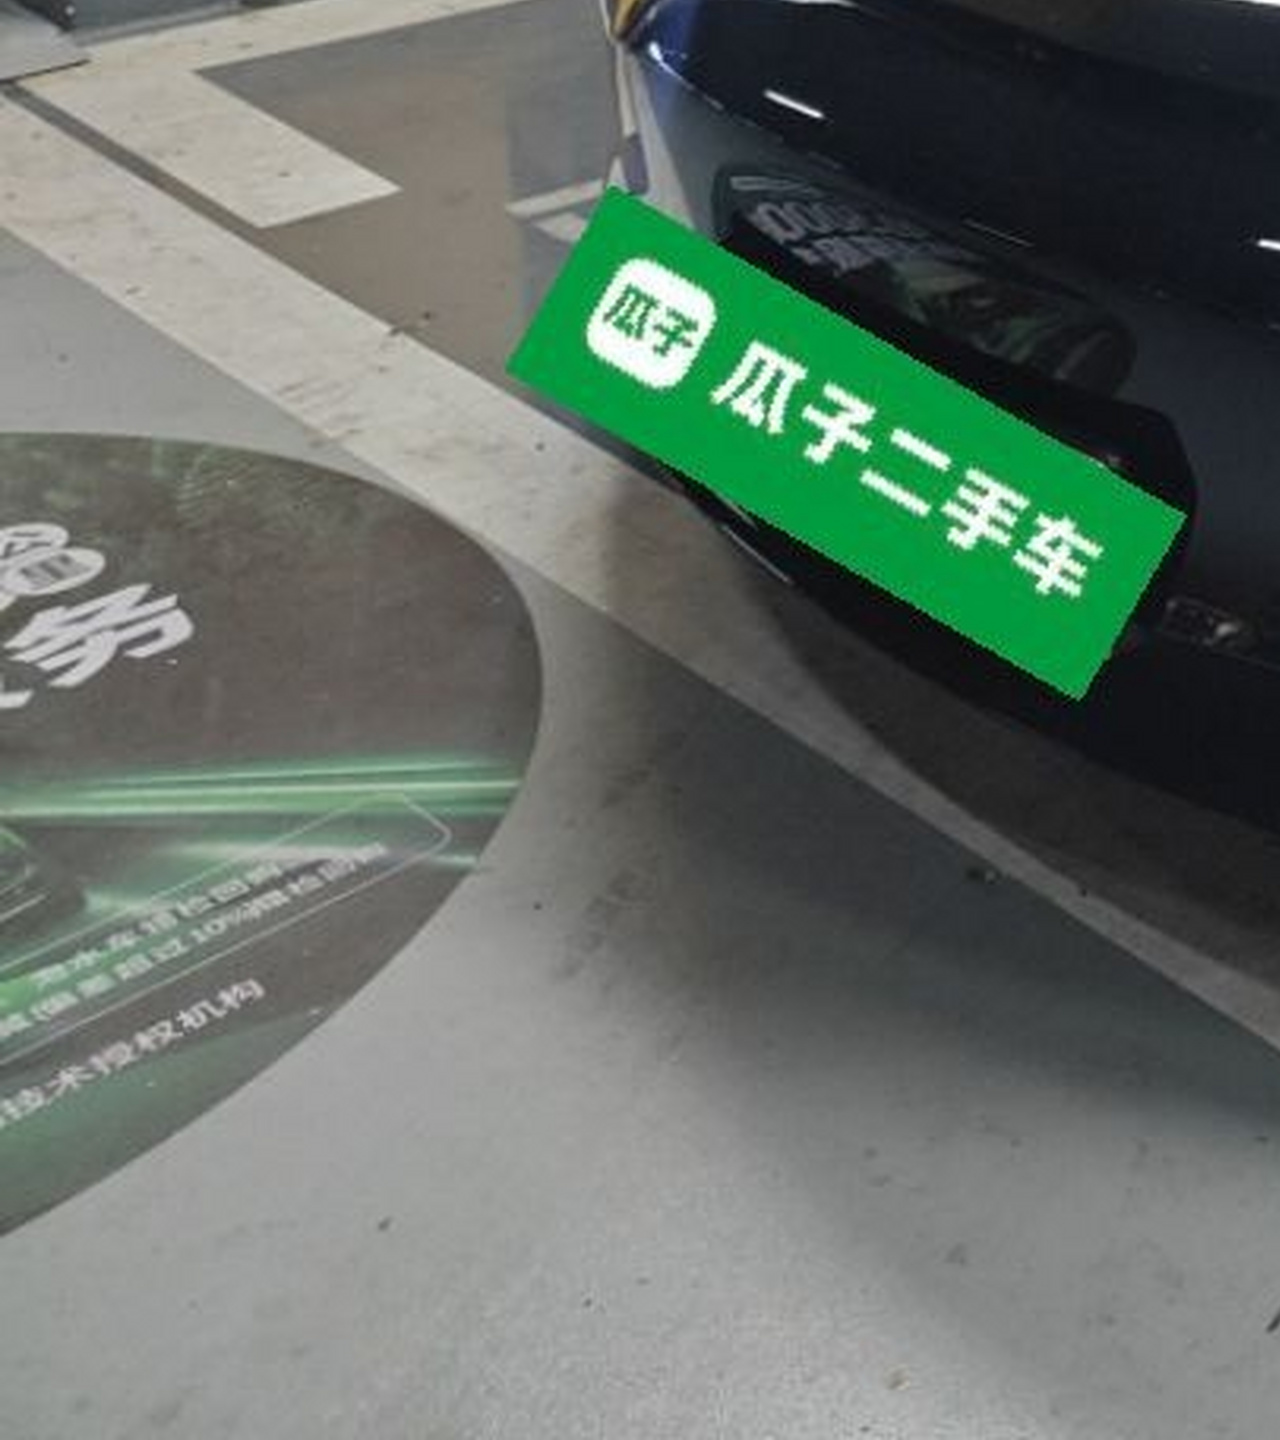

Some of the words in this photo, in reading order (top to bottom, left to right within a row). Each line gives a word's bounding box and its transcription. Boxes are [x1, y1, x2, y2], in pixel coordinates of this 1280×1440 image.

[0, 582, 195, 709] 务
[0, 976, 265, 1125] 技术授权机构
